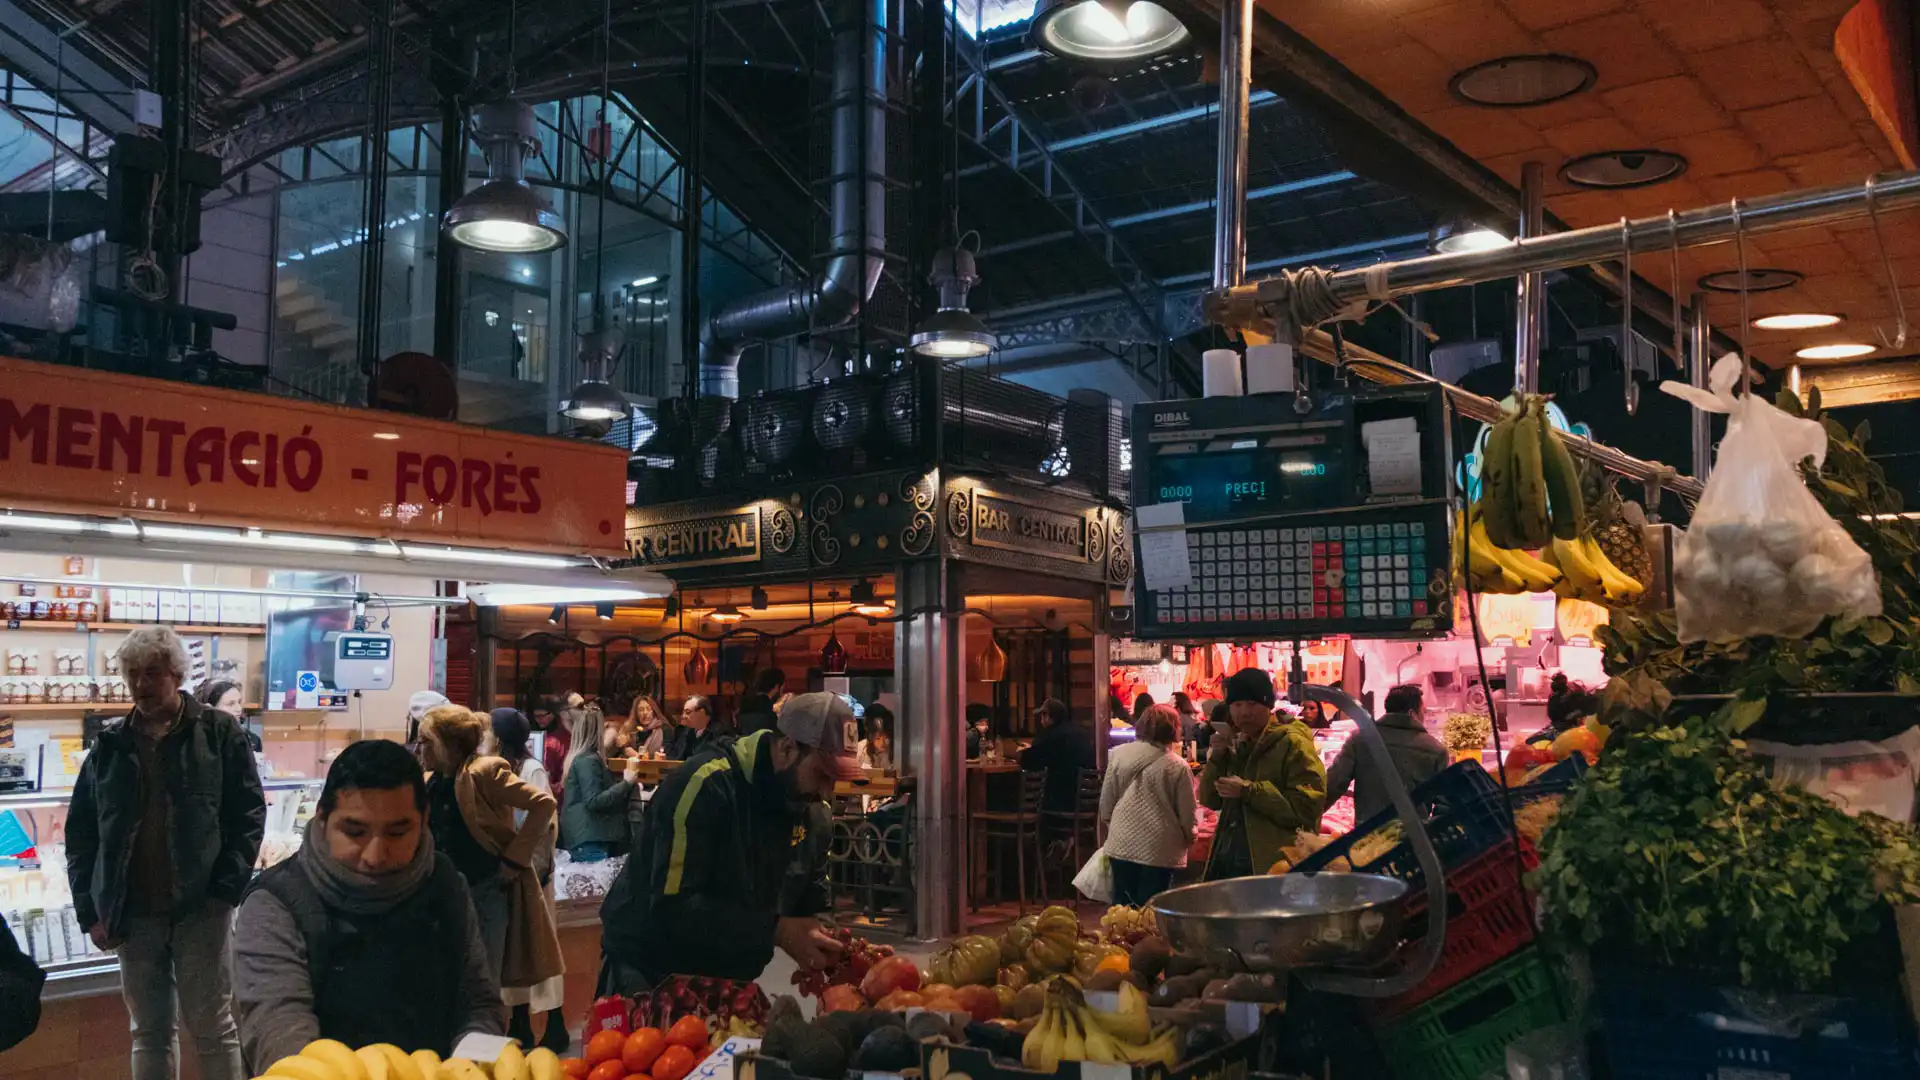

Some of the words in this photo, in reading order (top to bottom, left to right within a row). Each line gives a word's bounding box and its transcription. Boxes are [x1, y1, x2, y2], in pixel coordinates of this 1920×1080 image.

[1154, 411, 1190, 423] DIBAL
[0, 398, 323, 492] MENTACIÓ
[396, 452, 541, 516] FORÉS
[625, 535, 646, 560] R
[653, 522, 755, 558] CENTRAL
[977, 504, 1010, 533] BAR
[1020, 515, 1083, 546] CENTRAL
